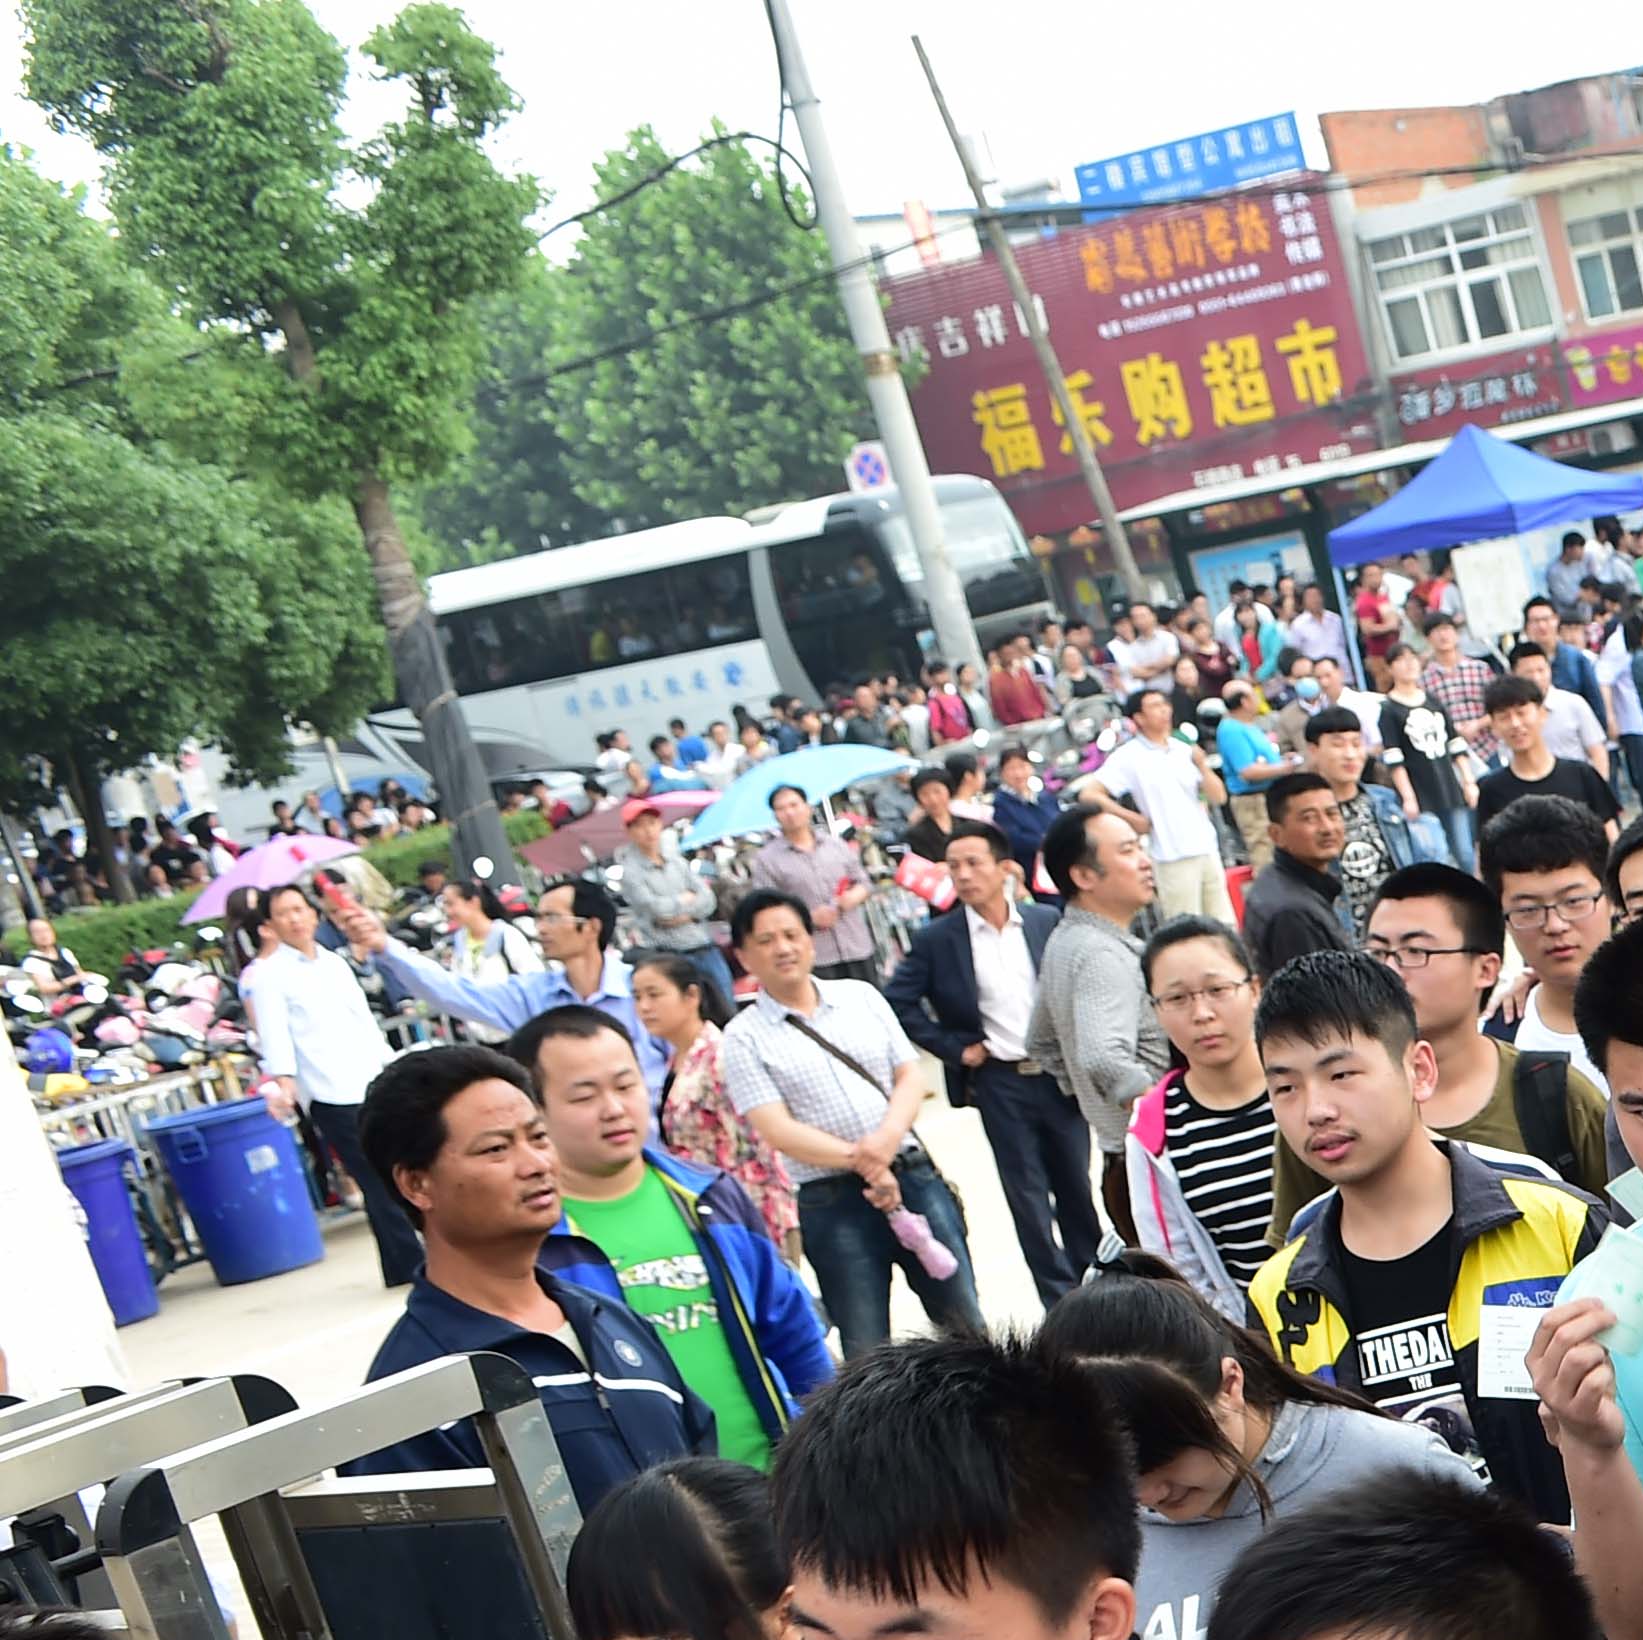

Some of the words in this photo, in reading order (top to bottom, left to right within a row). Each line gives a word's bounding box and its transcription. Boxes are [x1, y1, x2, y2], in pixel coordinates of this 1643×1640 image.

[971, 317, 1345, 478] 福乐购超市
[1408, 1372, 1434, 1391] THE
